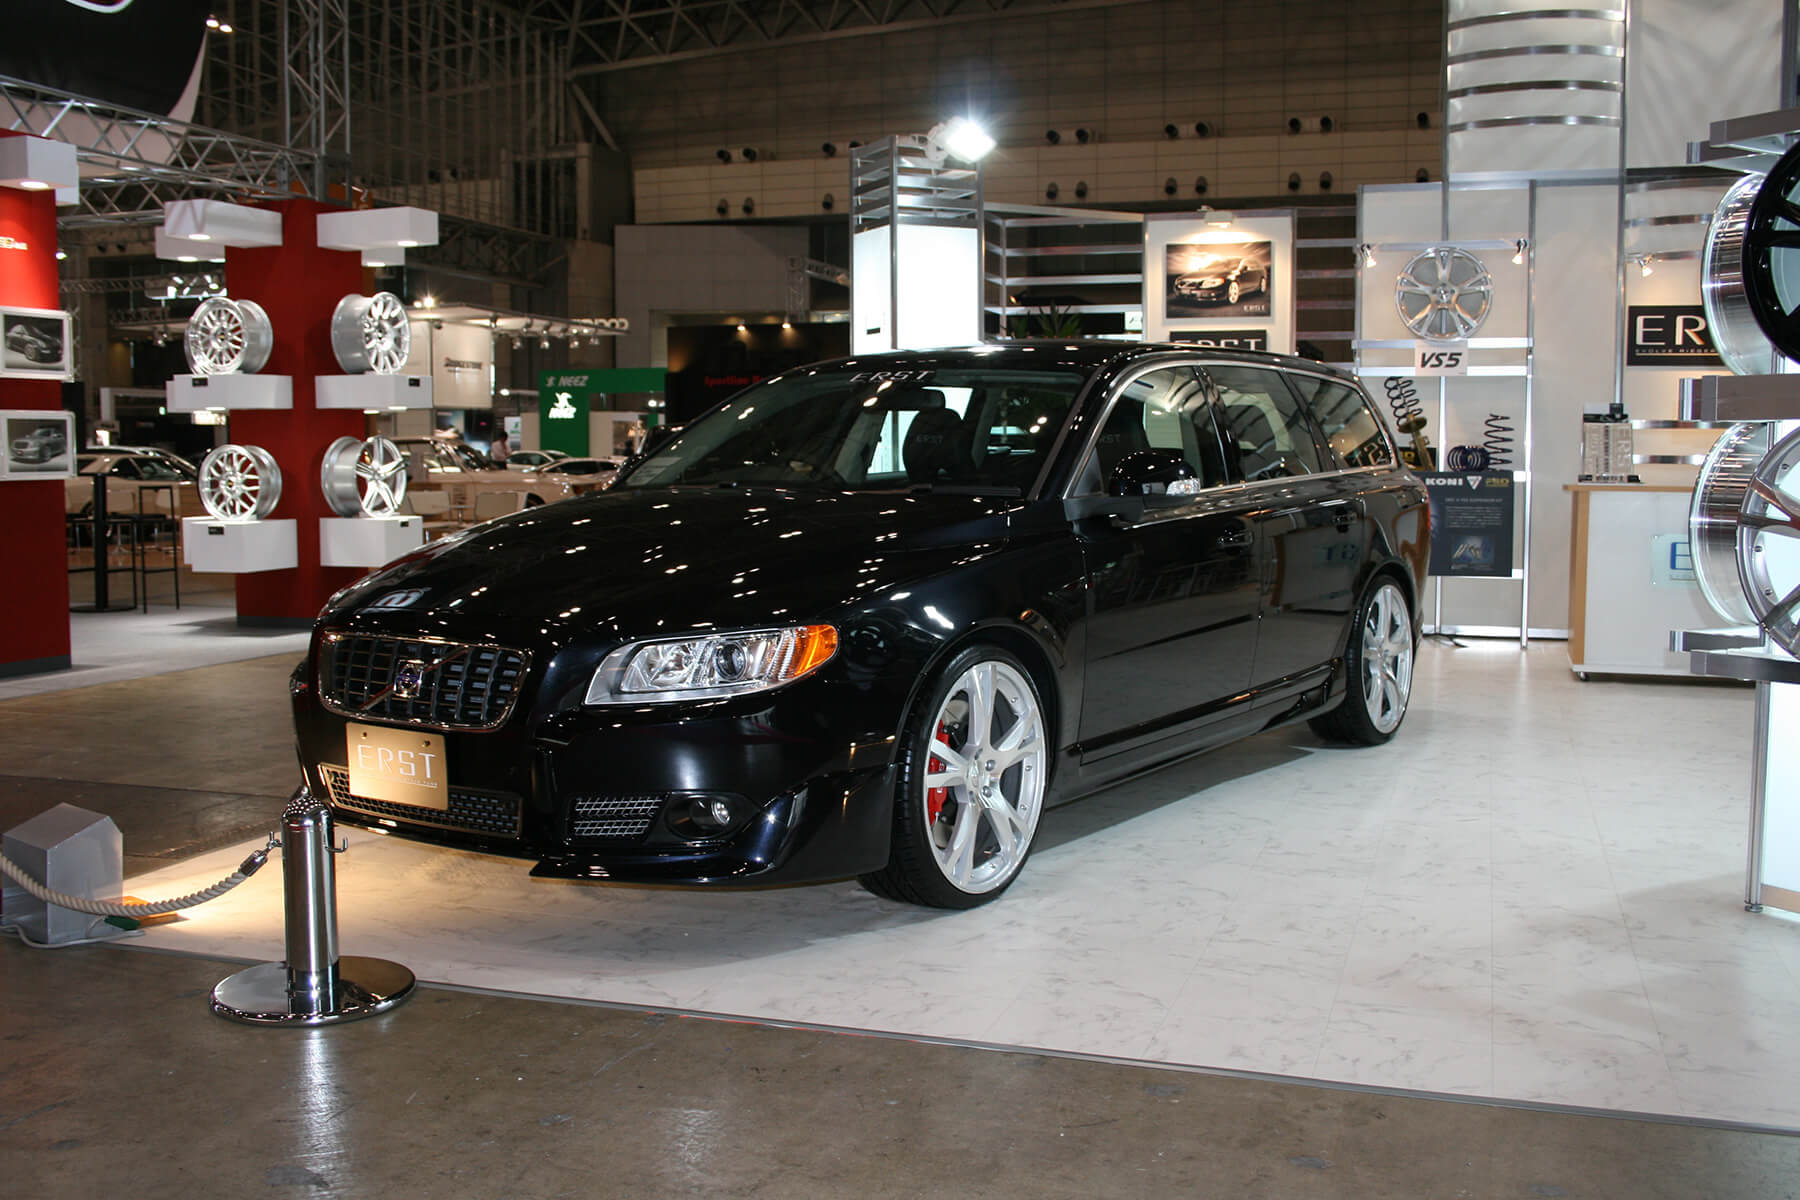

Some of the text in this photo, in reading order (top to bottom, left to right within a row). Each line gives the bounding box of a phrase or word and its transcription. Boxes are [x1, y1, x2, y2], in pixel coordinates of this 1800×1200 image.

[1635, 314, 1707, 346] ER
[1420, 352, 1462, 368] VS5
[849, 370, 935, 382] ERST
[1424, 477, 1464, 486] KONI
[357, 744, 437, 779] ERST
